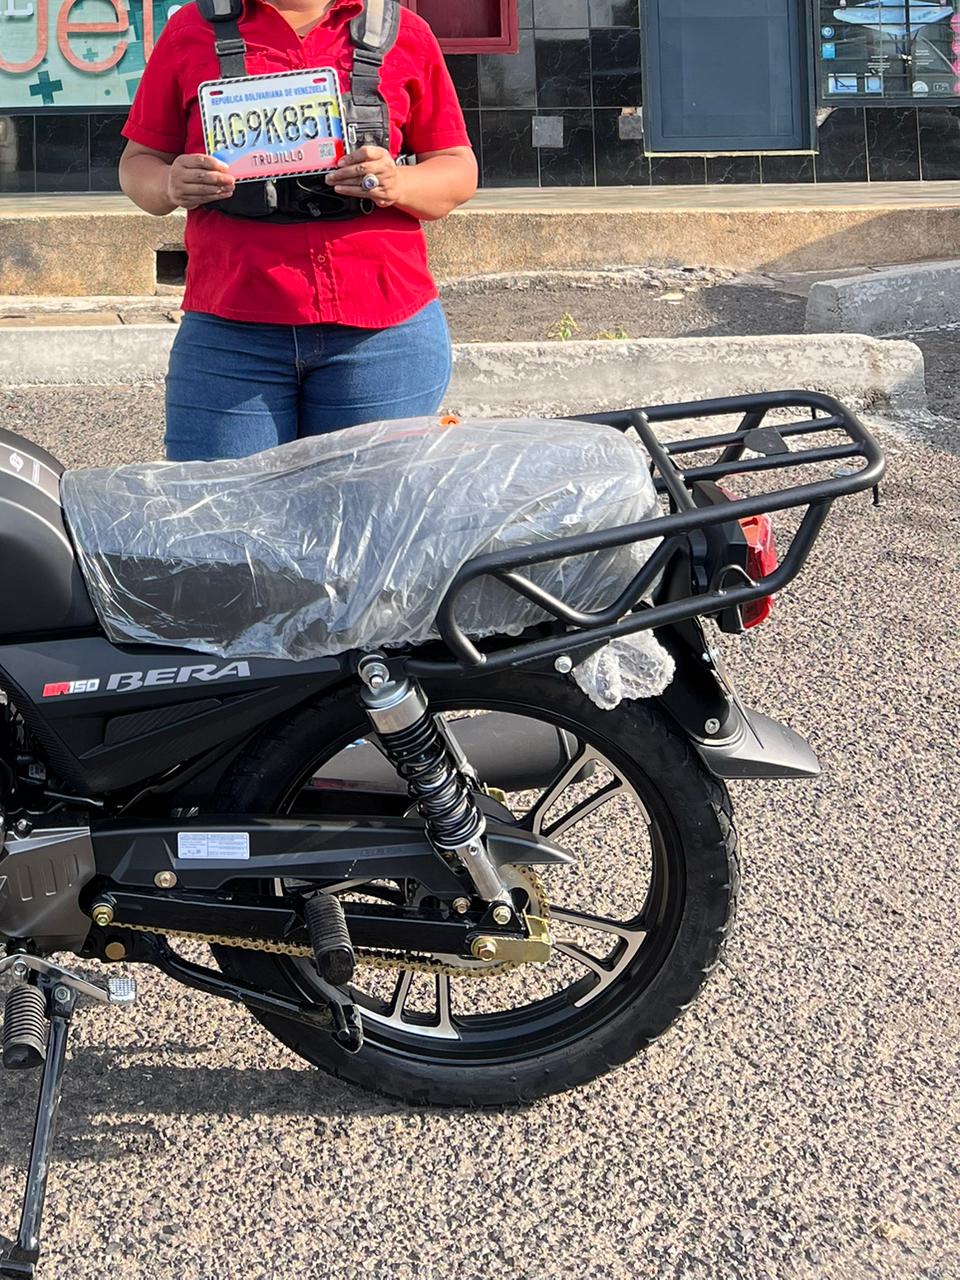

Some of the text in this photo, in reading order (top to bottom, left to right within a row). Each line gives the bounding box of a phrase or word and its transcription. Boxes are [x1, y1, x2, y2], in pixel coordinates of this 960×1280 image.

[244, 90, 284, 102] BOLIVARIANA
[284, 88, 294, 96] DE
[294, 84, 328, 96] VENEZUELA
[211, 100, 335, 151] AG9K85T
[251, 149, 305, 166] TRUJILLO
[106, 660, 252, 692] BERA
